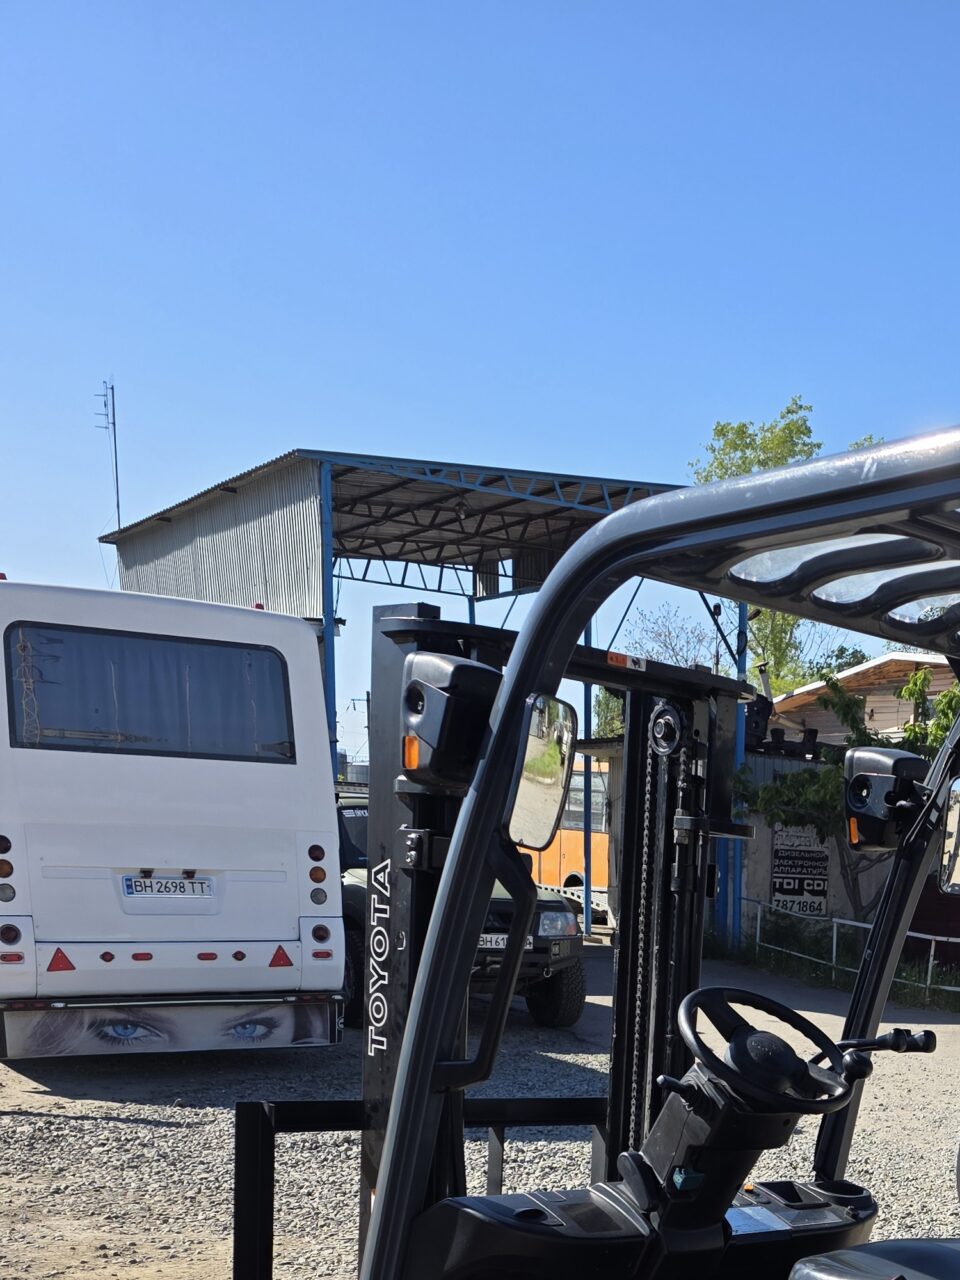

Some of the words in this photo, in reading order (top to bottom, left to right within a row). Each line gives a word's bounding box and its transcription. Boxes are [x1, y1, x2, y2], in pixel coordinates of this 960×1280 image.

[133, 880, 154, 893] BH
[155, 880, 186, 894] 2698
[188, 881, 206, 894] TT
[773, 878, 799, 889] TDI
[803, 879, 828, 891] CDI
[774, 899, 823, 914] 7871864
[368, 858, 391, 1056] TOYOTA
